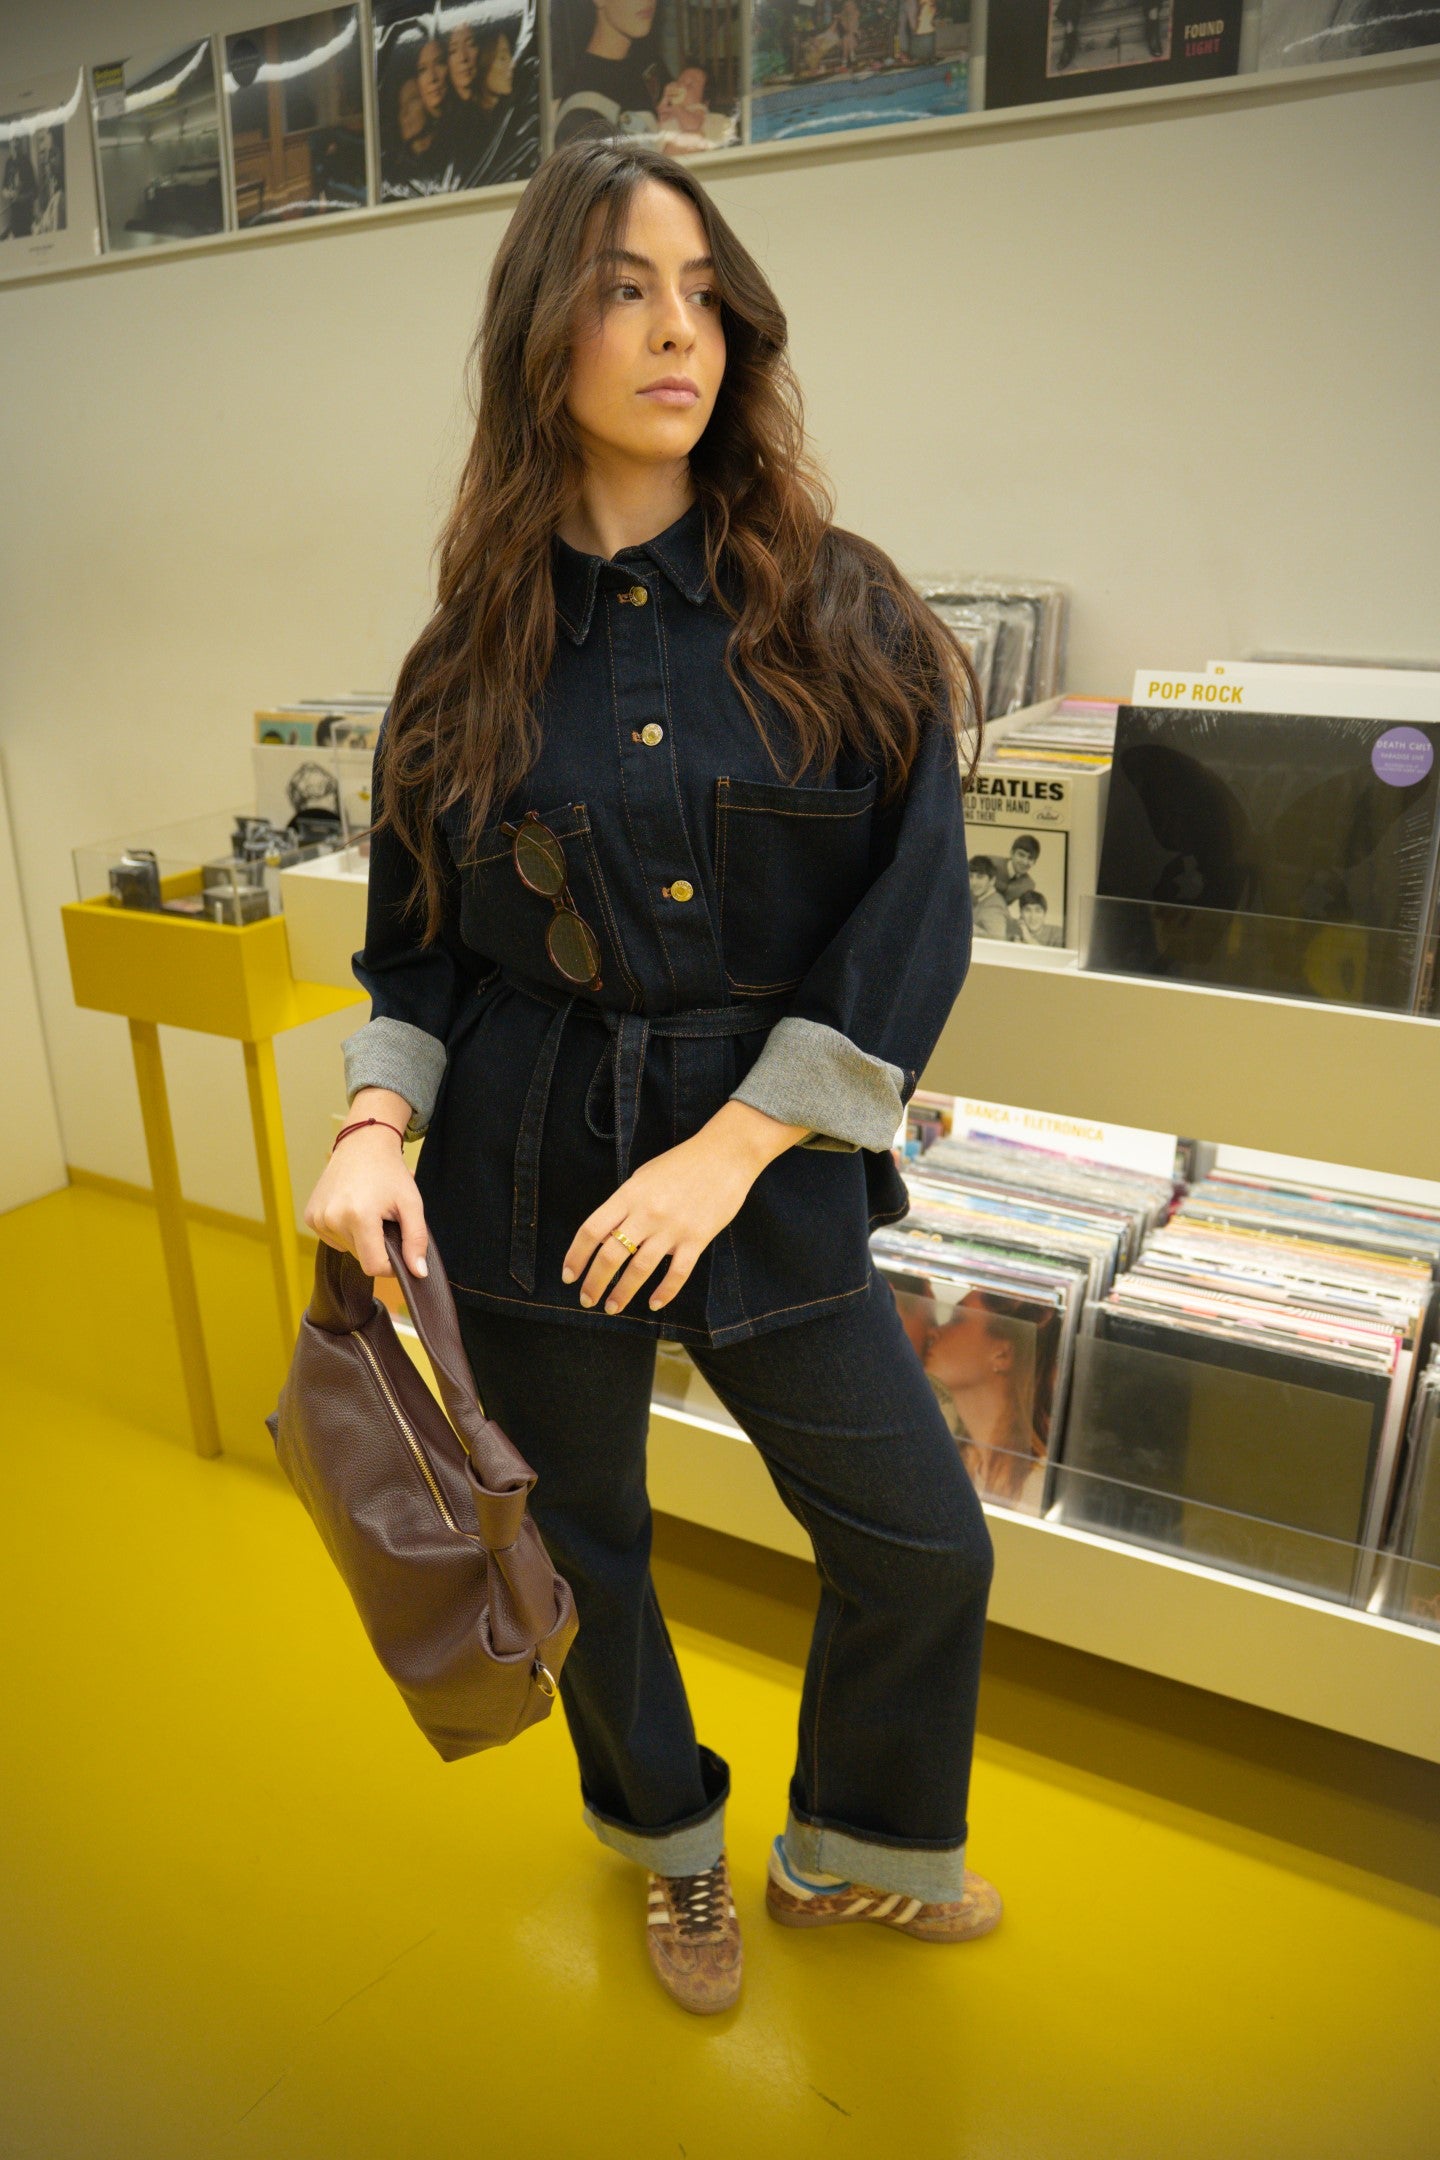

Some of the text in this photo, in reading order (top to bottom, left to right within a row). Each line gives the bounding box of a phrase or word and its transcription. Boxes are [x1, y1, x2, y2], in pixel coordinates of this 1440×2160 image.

[1184, 20, 1225, 39] FOUND
[1185, 39, 1220, 57] LIGHT
[1147, 681, 1244, 705] POP ROCK
[1376, 739, 1406, 750] DEATH
[980, 797, 1003, 812] YOUR
[1005, 799, 1031, 815] HAND
[976, 810, 998, 823] THERE
